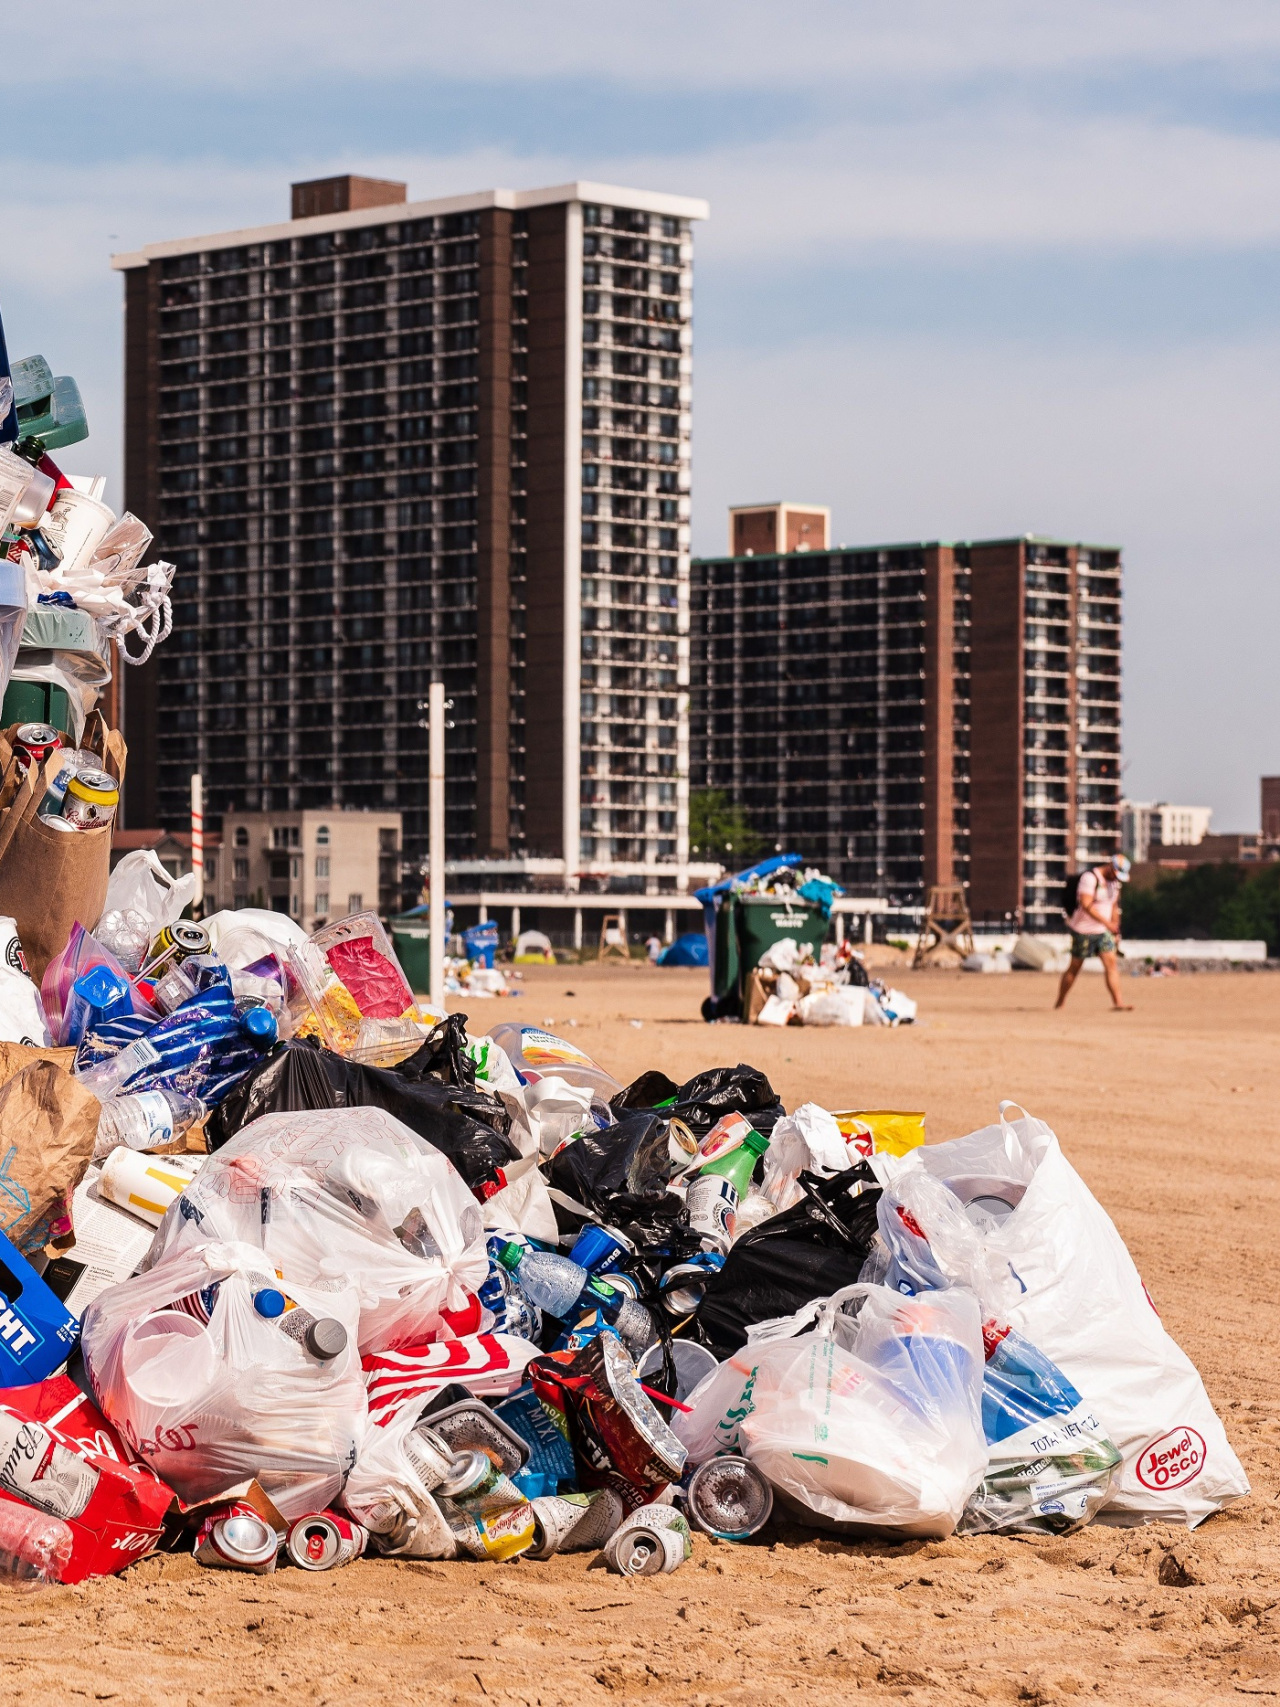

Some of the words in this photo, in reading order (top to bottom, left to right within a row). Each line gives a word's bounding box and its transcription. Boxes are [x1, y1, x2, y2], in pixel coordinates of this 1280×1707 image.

[600, 1247, 622, 1270] BUD
[526, 1406, 559, 1445] MIX!
[1147, 1430, 1193, 1474] Jewel
[1154, 1450, 1199, 1486] Osco
